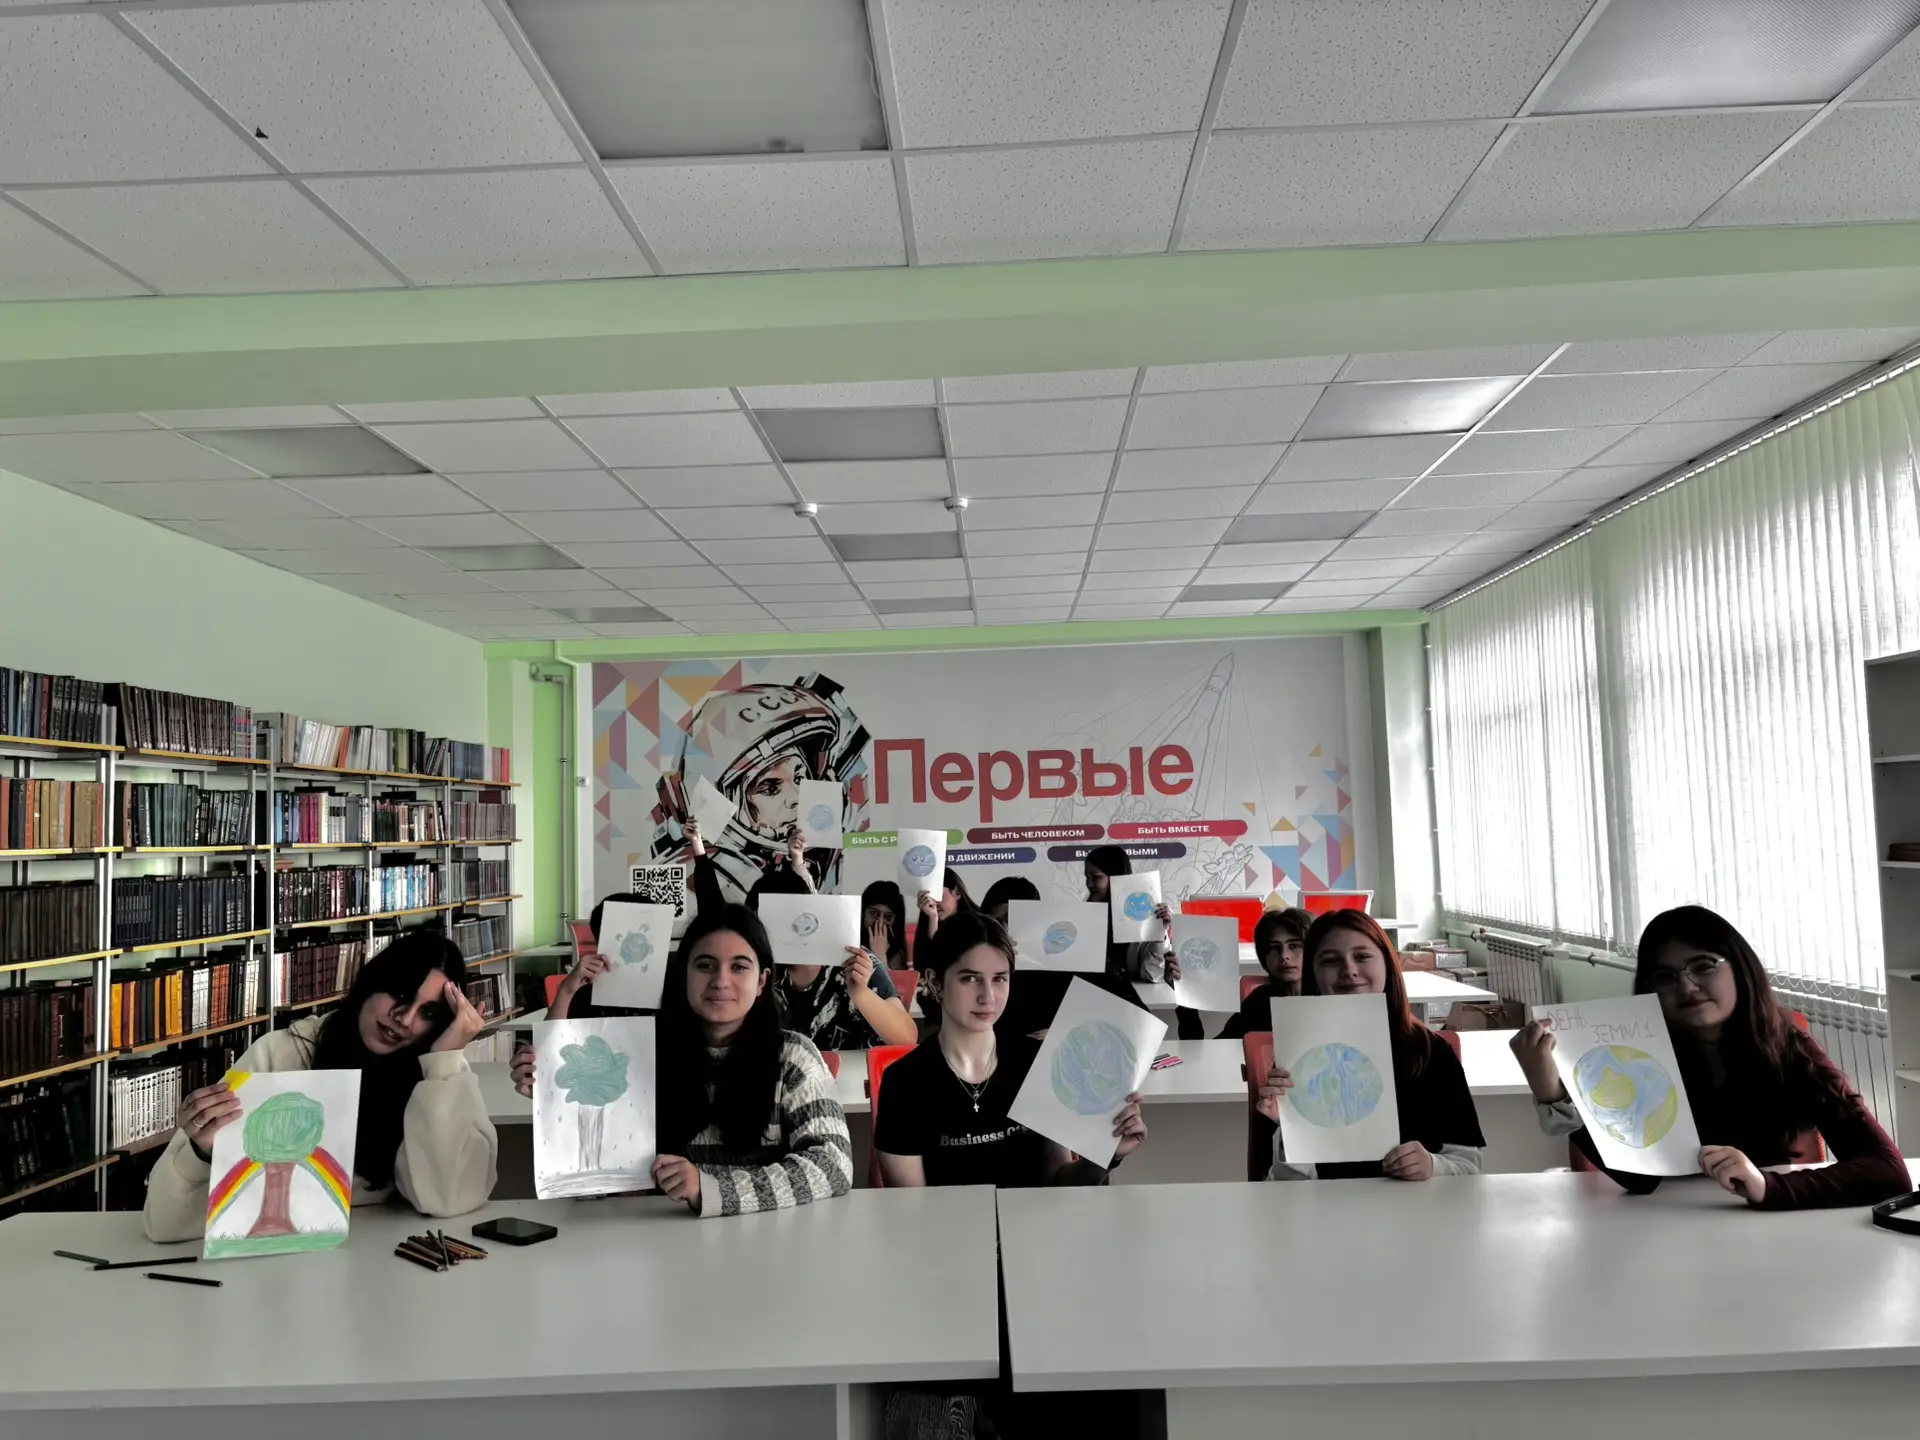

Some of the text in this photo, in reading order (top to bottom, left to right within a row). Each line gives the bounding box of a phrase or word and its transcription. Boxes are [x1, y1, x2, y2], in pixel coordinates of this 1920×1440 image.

[873, 738, 1194, 823] Первые
[991, 829, 1085, 840] БЫТЬ ЧЕЛОВЕКОМ
[1137, 825, 1210, 835] БЫТЬ ВМЕСТЕ
[851, 836, 880, 845] БЫТЬ
[881, 836, 889, 844] С
[947, 852, 1016, 863] В ДВИЖЕНИИ
[939, 1131, 1005, 1146] Business
